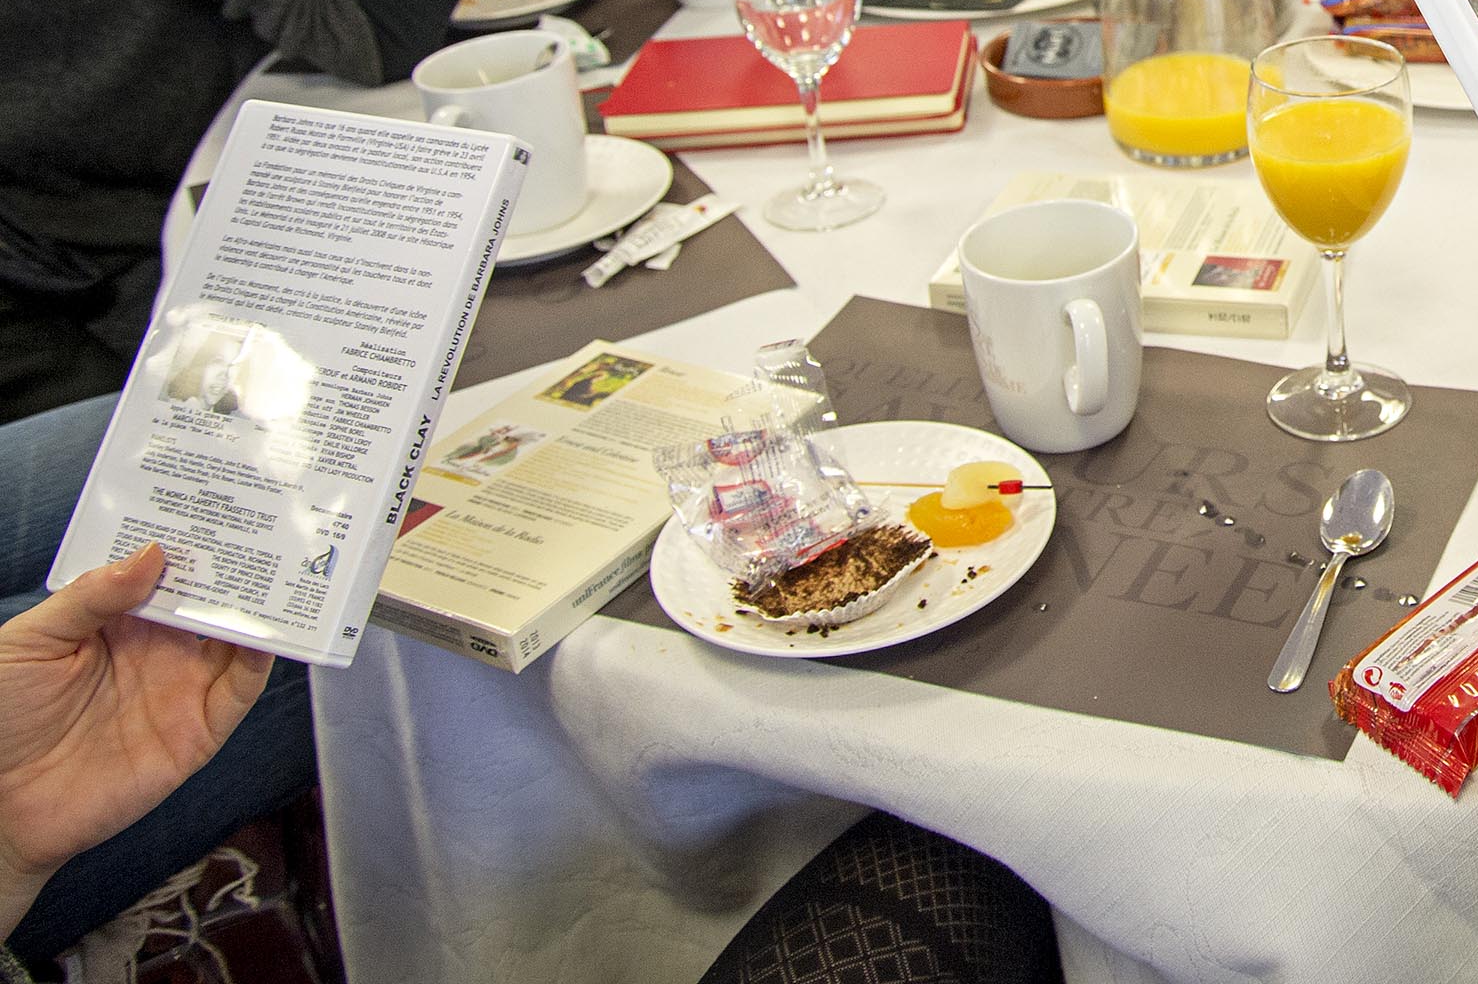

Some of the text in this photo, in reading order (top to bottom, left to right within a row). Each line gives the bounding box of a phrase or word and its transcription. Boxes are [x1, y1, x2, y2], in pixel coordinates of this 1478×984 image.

[431, 196, 510, 402] LA REVOLUTION DE BARBARA JOHNS
[385, 412, 432, 526] BLACK CLAY
